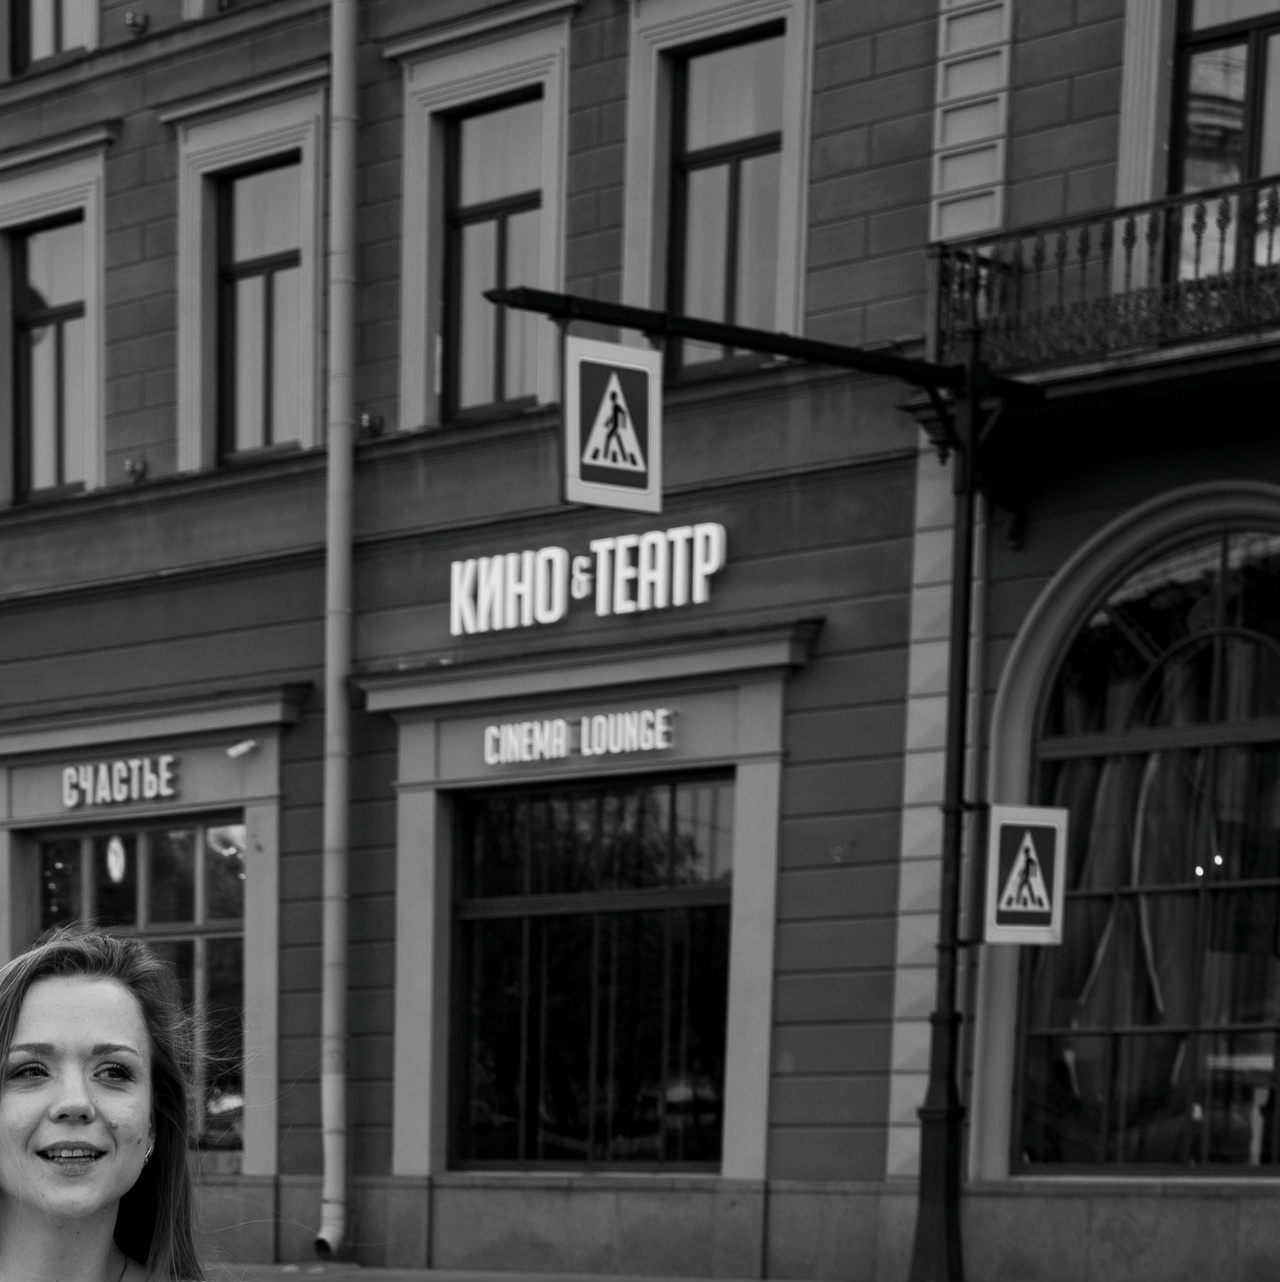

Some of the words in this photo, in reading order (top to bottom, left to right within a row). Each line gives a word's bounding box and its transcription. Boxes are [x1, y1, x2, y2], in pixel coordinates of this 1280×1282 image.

[484, 718, 568, 765] CINEMA
[580, 708, 671, 756] LOUNGE
[62, 754, 175, 808] СЧАСТЬЕ
